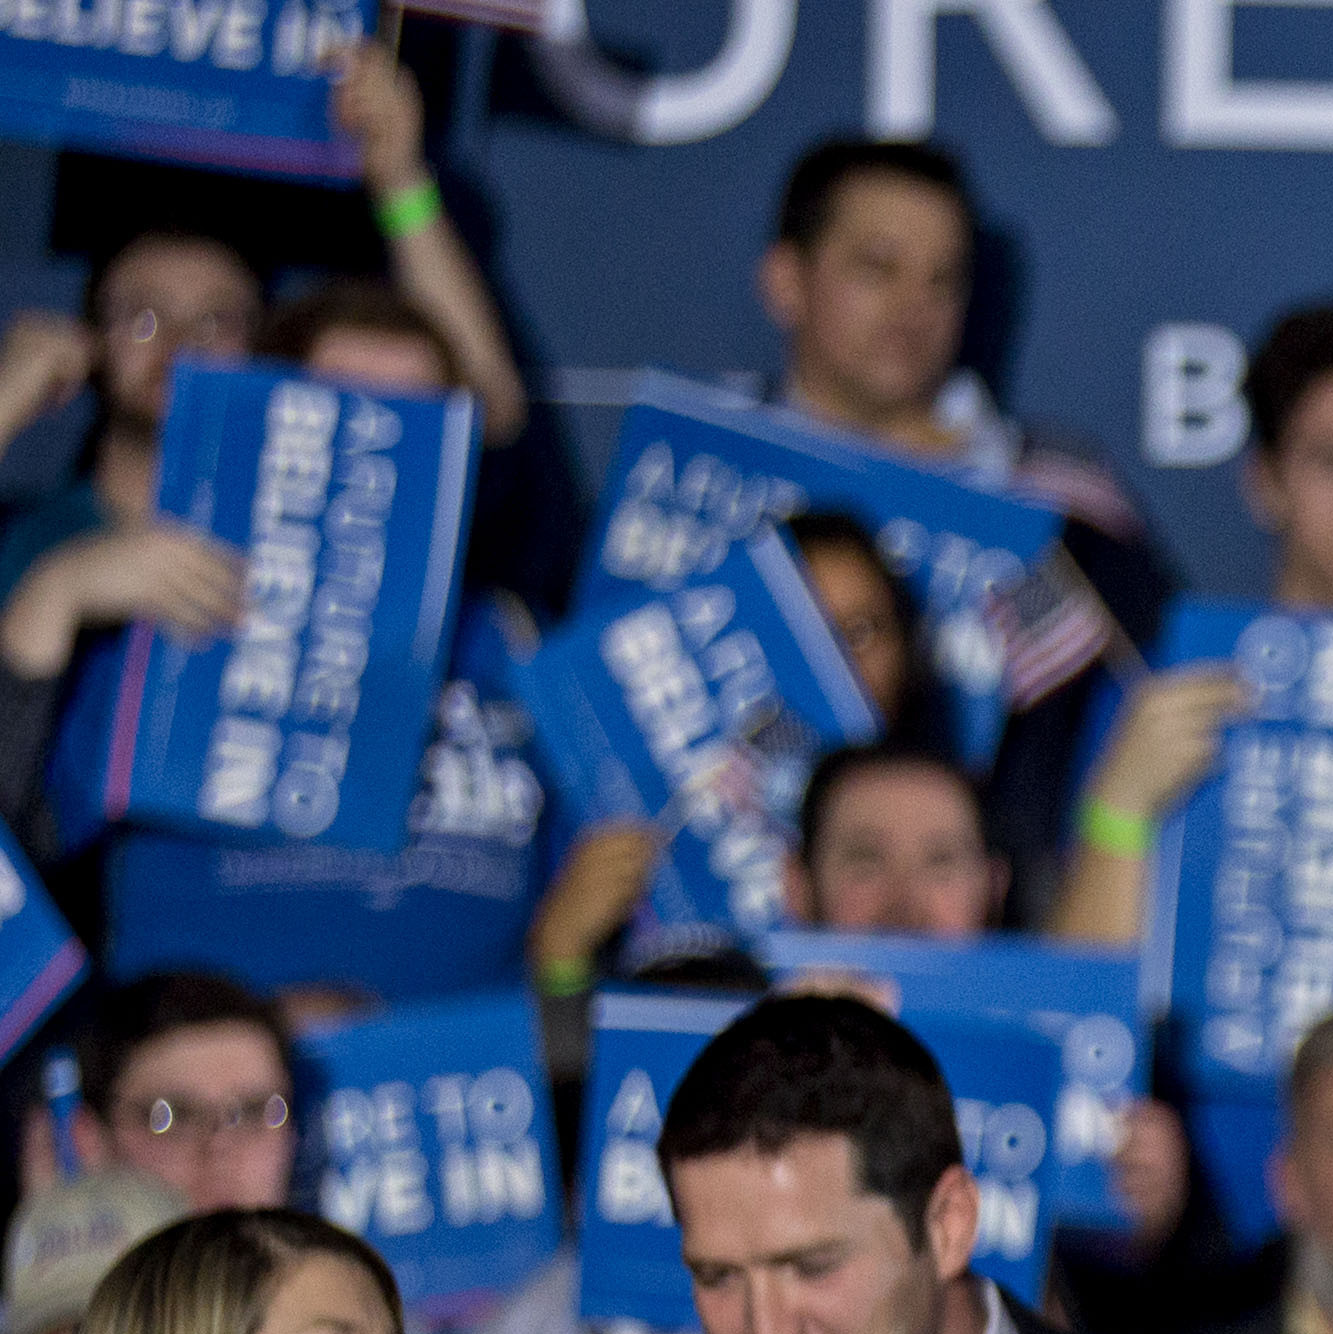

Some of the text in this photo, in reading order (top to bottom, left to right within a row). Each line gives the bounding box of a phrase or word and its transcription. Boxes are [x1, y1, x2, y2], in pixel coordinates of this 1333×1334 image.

[218, 378, 342, 722] BELIEVE
[270, 393, 402, 840] A FUTURE TO
